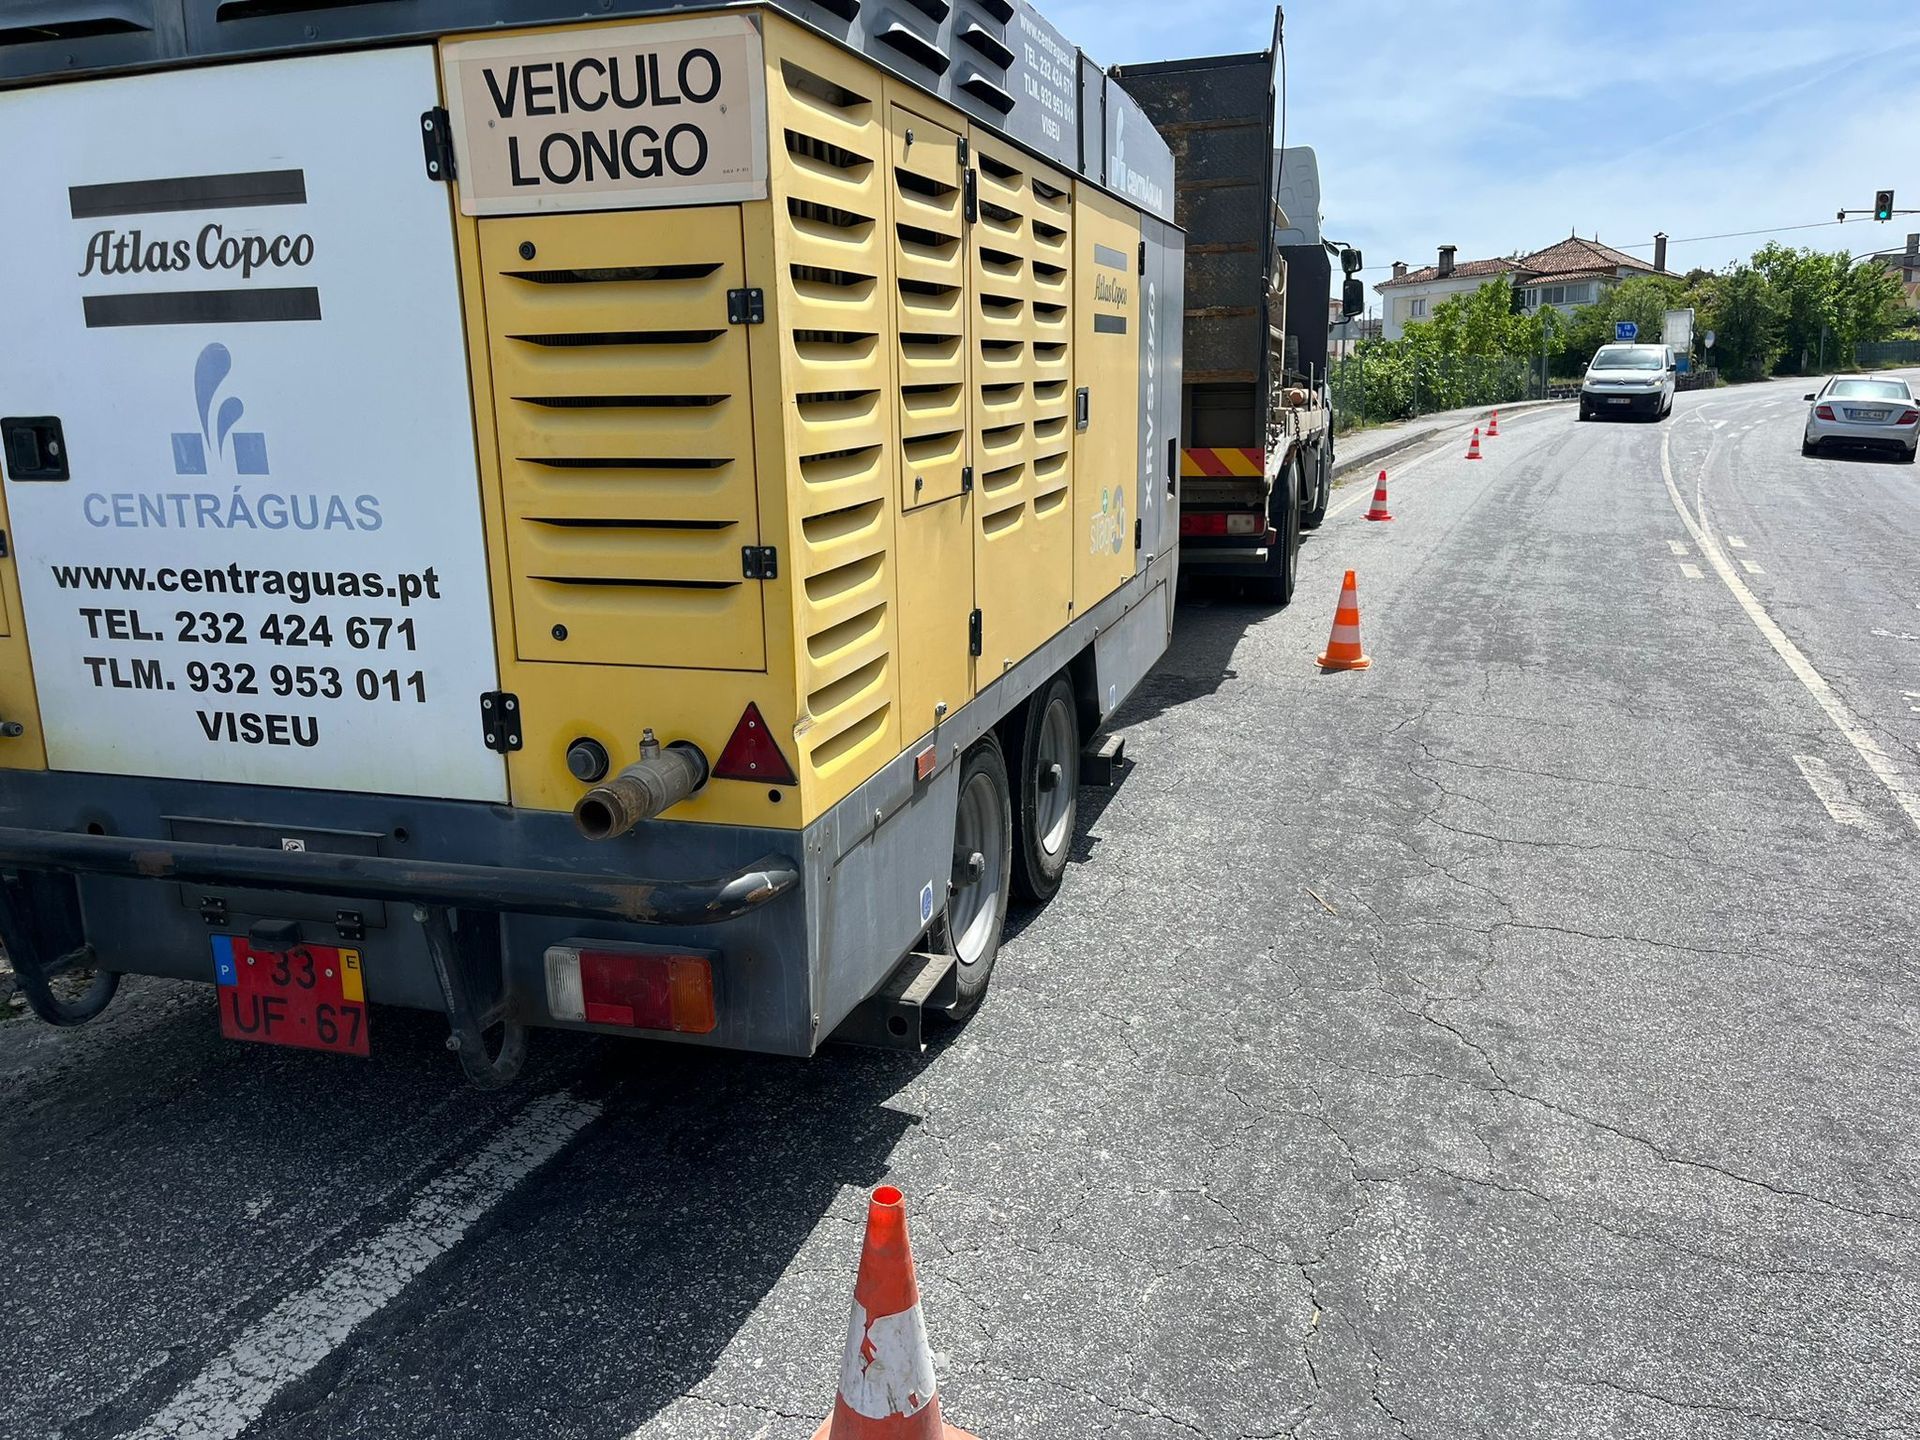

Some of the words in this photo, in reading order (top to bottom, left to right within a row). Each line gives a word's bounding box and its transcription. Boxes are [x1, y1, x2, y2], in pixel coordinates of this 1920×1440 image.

[483, 48, 722, 119] VEICULO
[1024, 43, 1039, 72] TEL.
[1040, 55, 1051, 81] 232
[1051, 66, 1063, 91] 424
[1024, 72, 1040, 101] TLM.
[1041, 85, 1052, 110] 932
[1041, 114, 1060, 142] VISEU
[508, 123, 708, 187] LONGO
[78, 229, 190, 277] Atlas
[197, 223, 314, 278] Copco
[83, 485, 382, 531] CENTRÁGUAS
[52, 561, 440, 605] www.centraguas.pt
[80, 607, 164, 643] TEL.
[174, 610, 247, 645] 232
[259, 613, 333, 648] 424
[345, 617, 417, 651] 671
[83, 656, 176, 691] TLM.
[186, 661, 258, 695] 932
[271, 665, 343, 699] 953
[355, 669, 427, 703] 011
[197, 710, 320, 748] VISEU
[221, 964, 229, 975] P
[271, 950, 316, 990] 33
[346, 955, 358, 970] E
